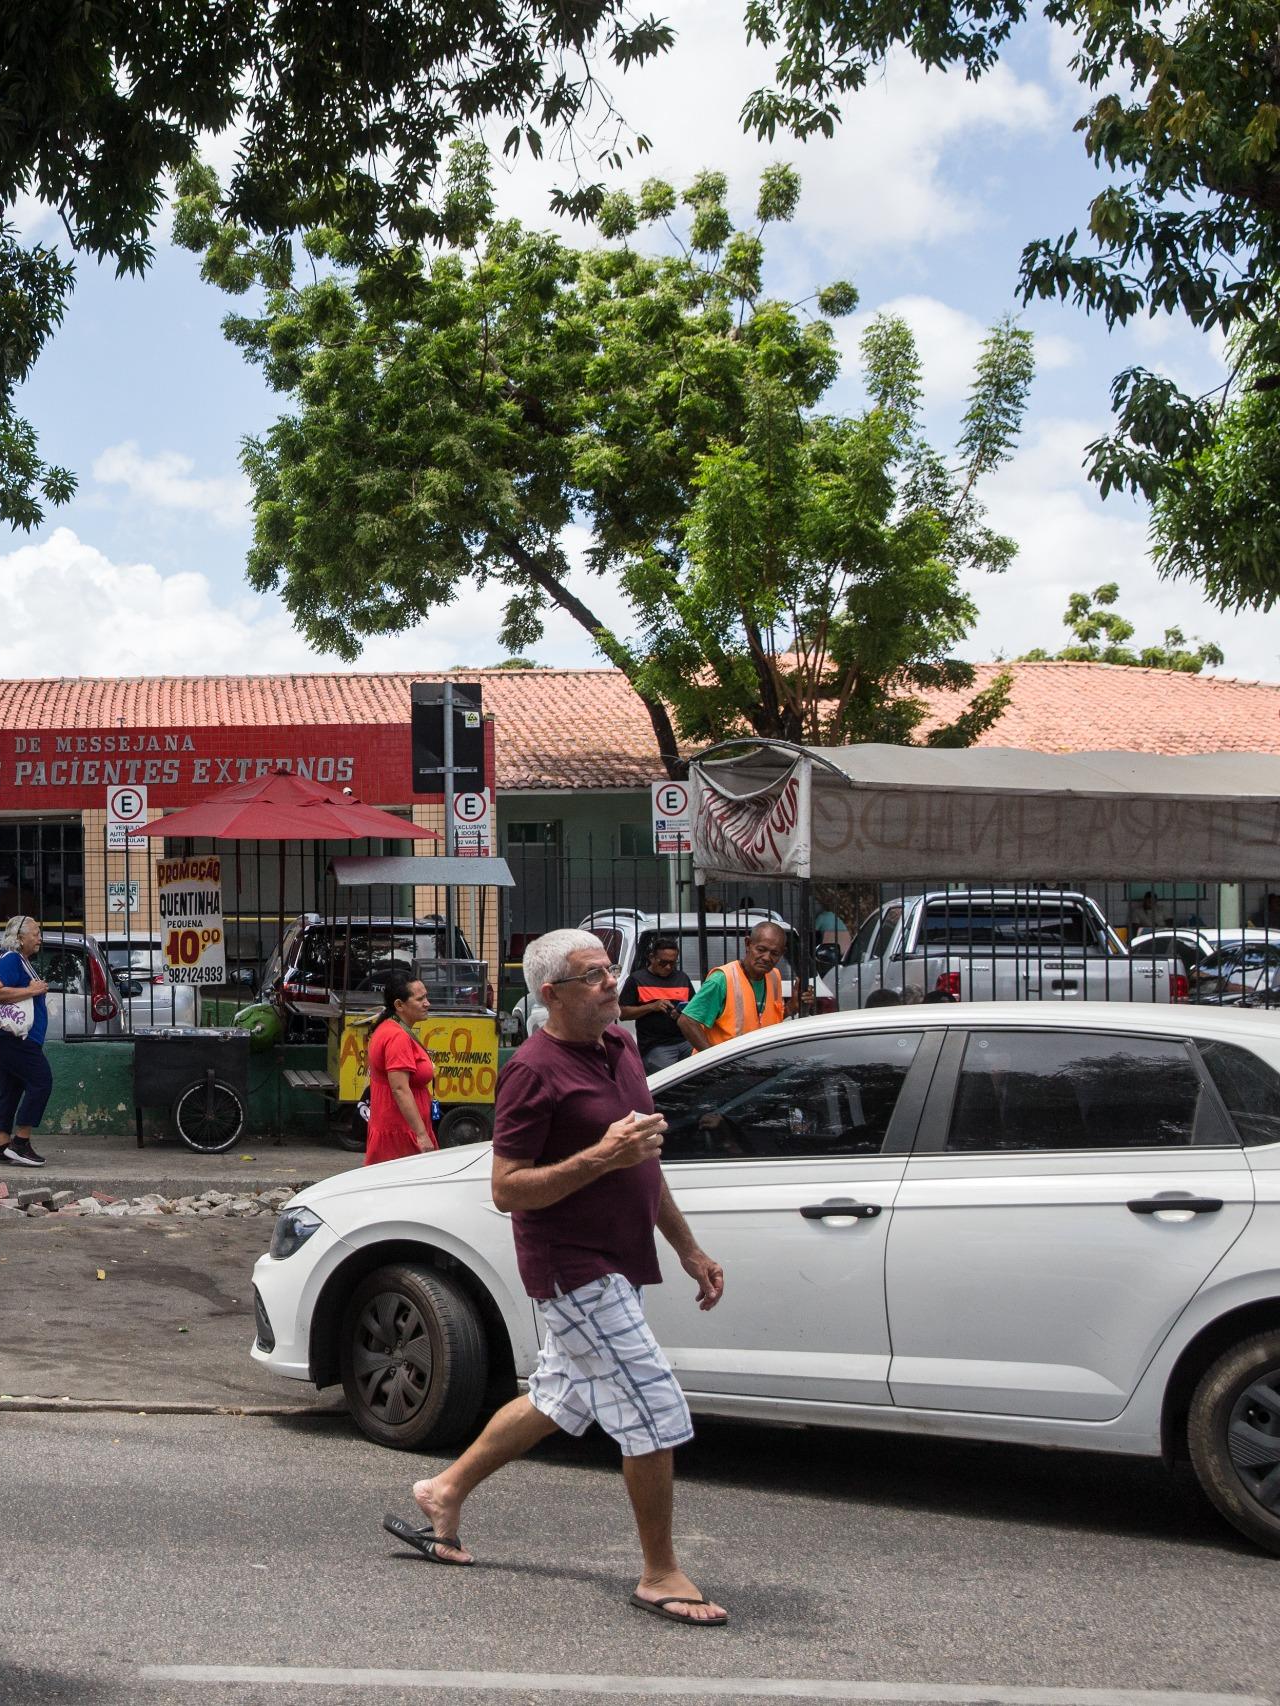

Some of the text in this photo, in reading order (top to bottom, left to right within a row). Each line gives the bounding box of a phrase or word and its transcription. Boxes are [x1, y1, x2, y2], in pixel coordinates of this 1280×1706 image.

[14, 737, 41, 753] DE
[55, 735, 196, 753] MESSEJANA
[14, 757, 180, 786] PACIENTES
[121, 796, 133, 813] E
[464, 798, 476, 815] E
[666, 792, 677, 809] E
[157, 858, 221, 886] PROMOÇÃO
[159, 891, 221, 919] QUENTINHA
[167, 919, 203, 929] PEQUENA
